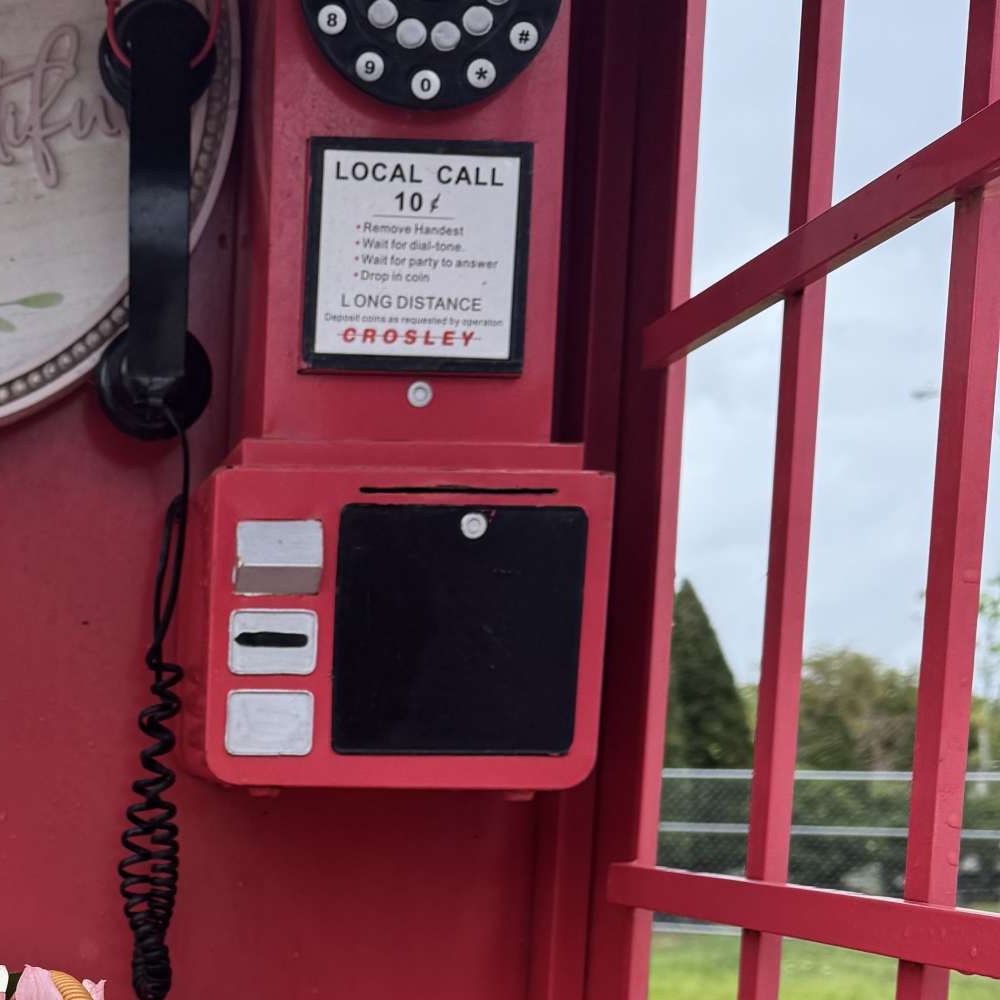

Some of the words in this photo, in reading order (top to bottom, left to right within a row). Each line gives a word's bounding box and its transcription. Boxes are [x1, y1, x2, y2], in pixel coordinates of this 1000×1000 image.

[336, 161, 423, 183] LOCAL
[437, 165, 504, 186] CALL
[363, 222, 411, 235] Remove
[362, 238, 389, 250] Wait
[391, 239, 407, 250] for
[361, 254, 388, 266] Wait
[390, 255, 406, 266] for
[408, 256, 439, 270] party
[441, 257, 453, 268] to
[455, 260, 498, 269] answer
[360, 270, 390, 283] Drop
[392, 271, 401, 282] in
[405, 272, 430, 283] coin
[341, 294, 393, 309] LONG
[396, 296, 482, 312] DISTANCE
[449, 317, 461, 327] by
[343, 327, 475, 346] CROSLEY
